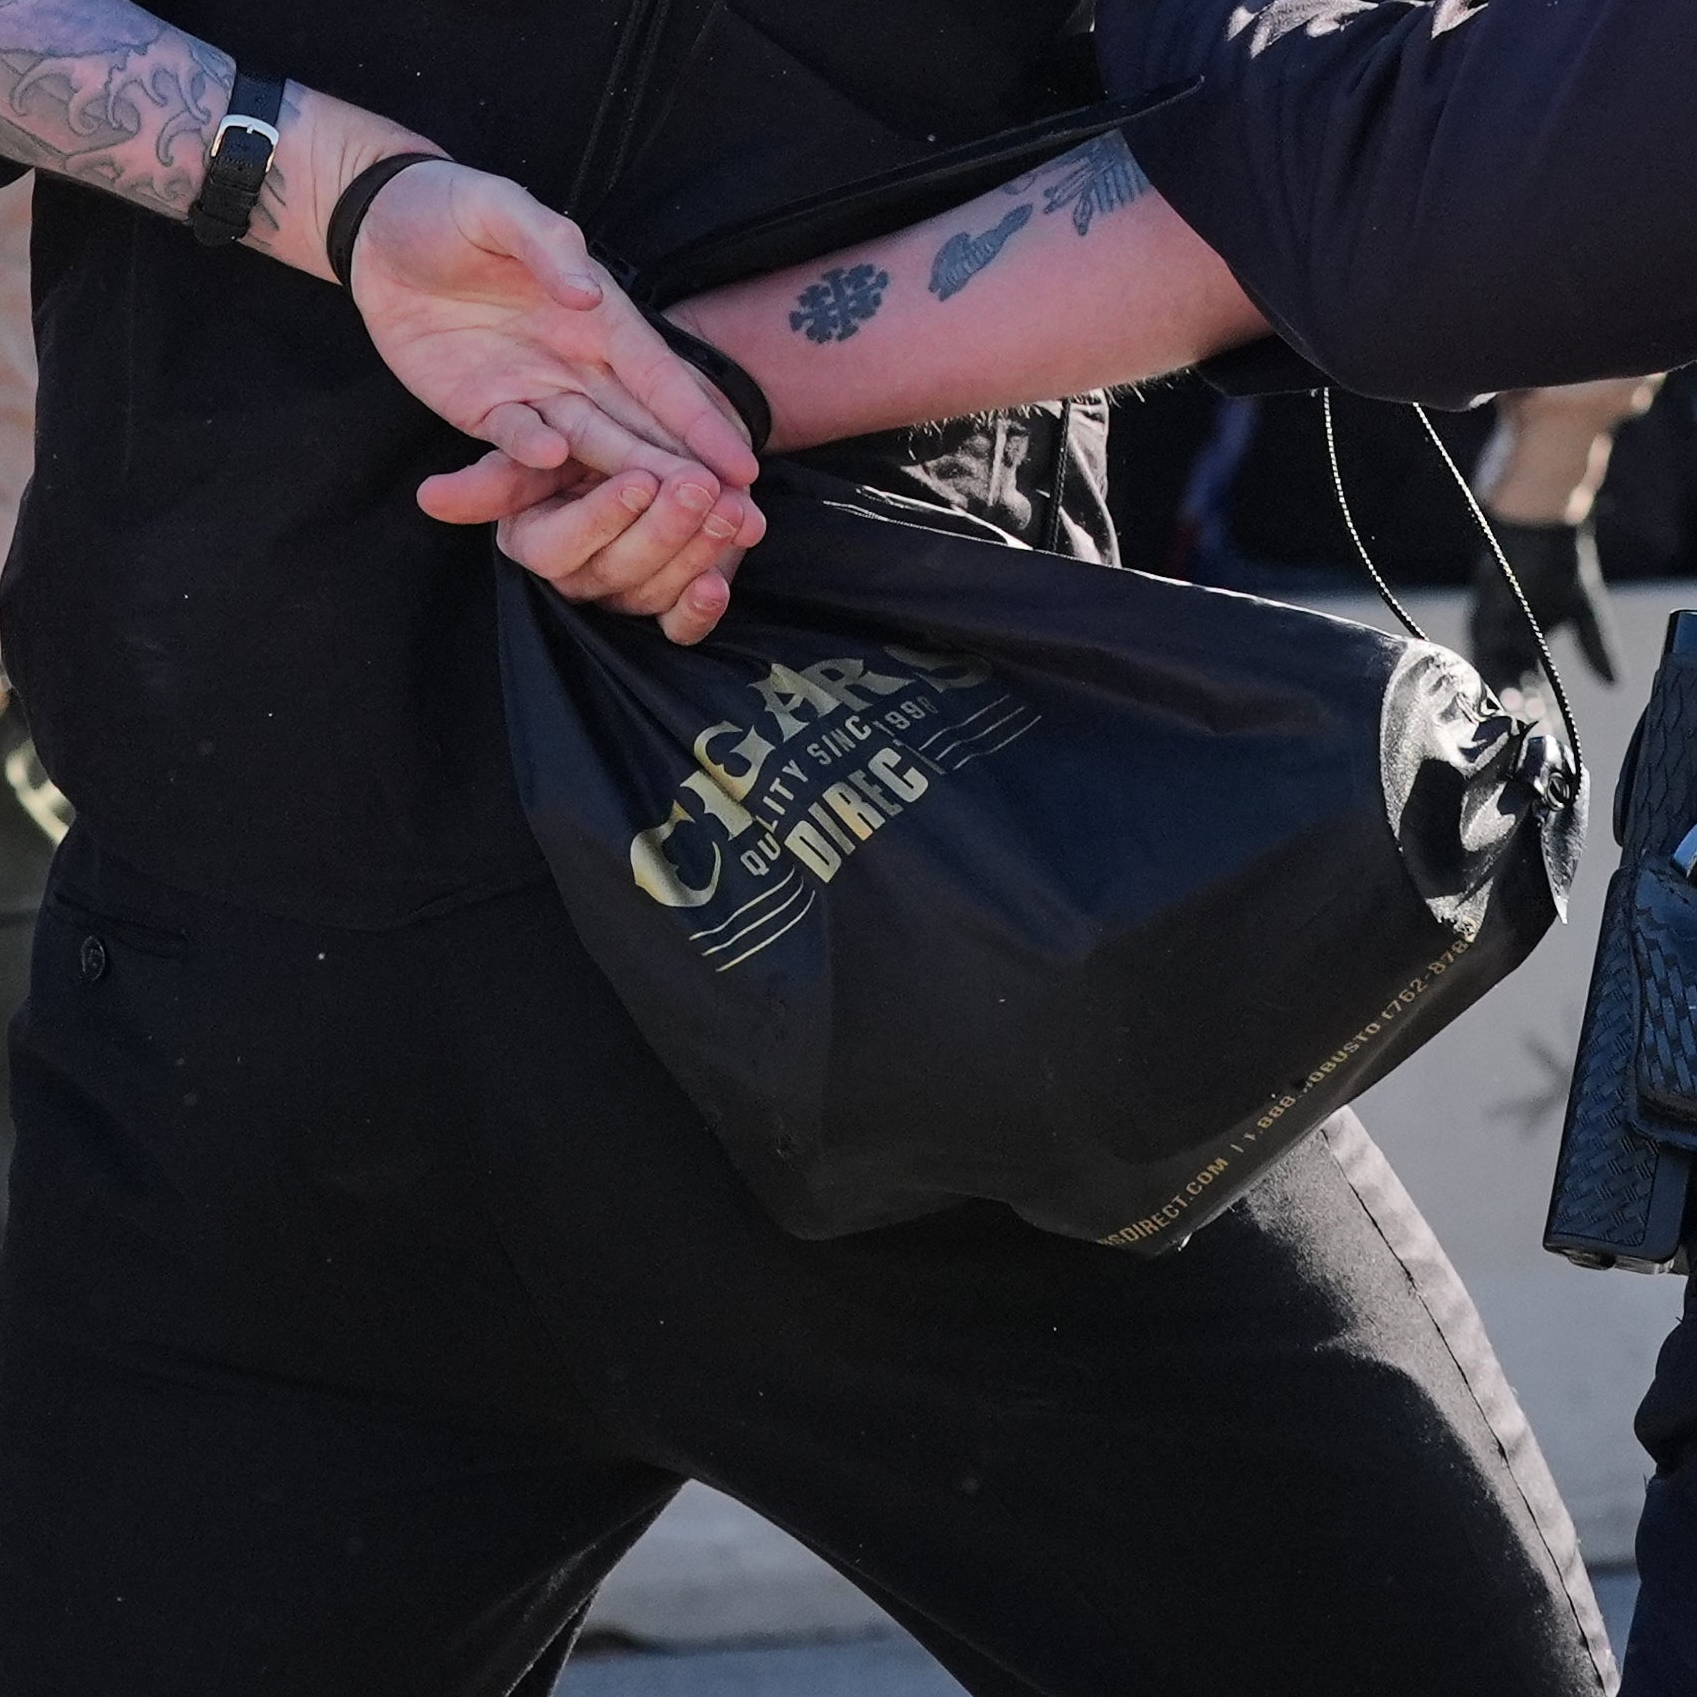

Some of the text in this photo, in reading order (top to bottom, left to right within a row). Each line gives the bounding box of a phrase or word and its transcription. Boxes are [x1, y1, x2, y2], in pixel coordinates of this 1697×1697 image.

[630, 645, 995, 908] CIGARS
[740, 759, 809, 876] QULITY
[806, 714, 873, 768] SINC
